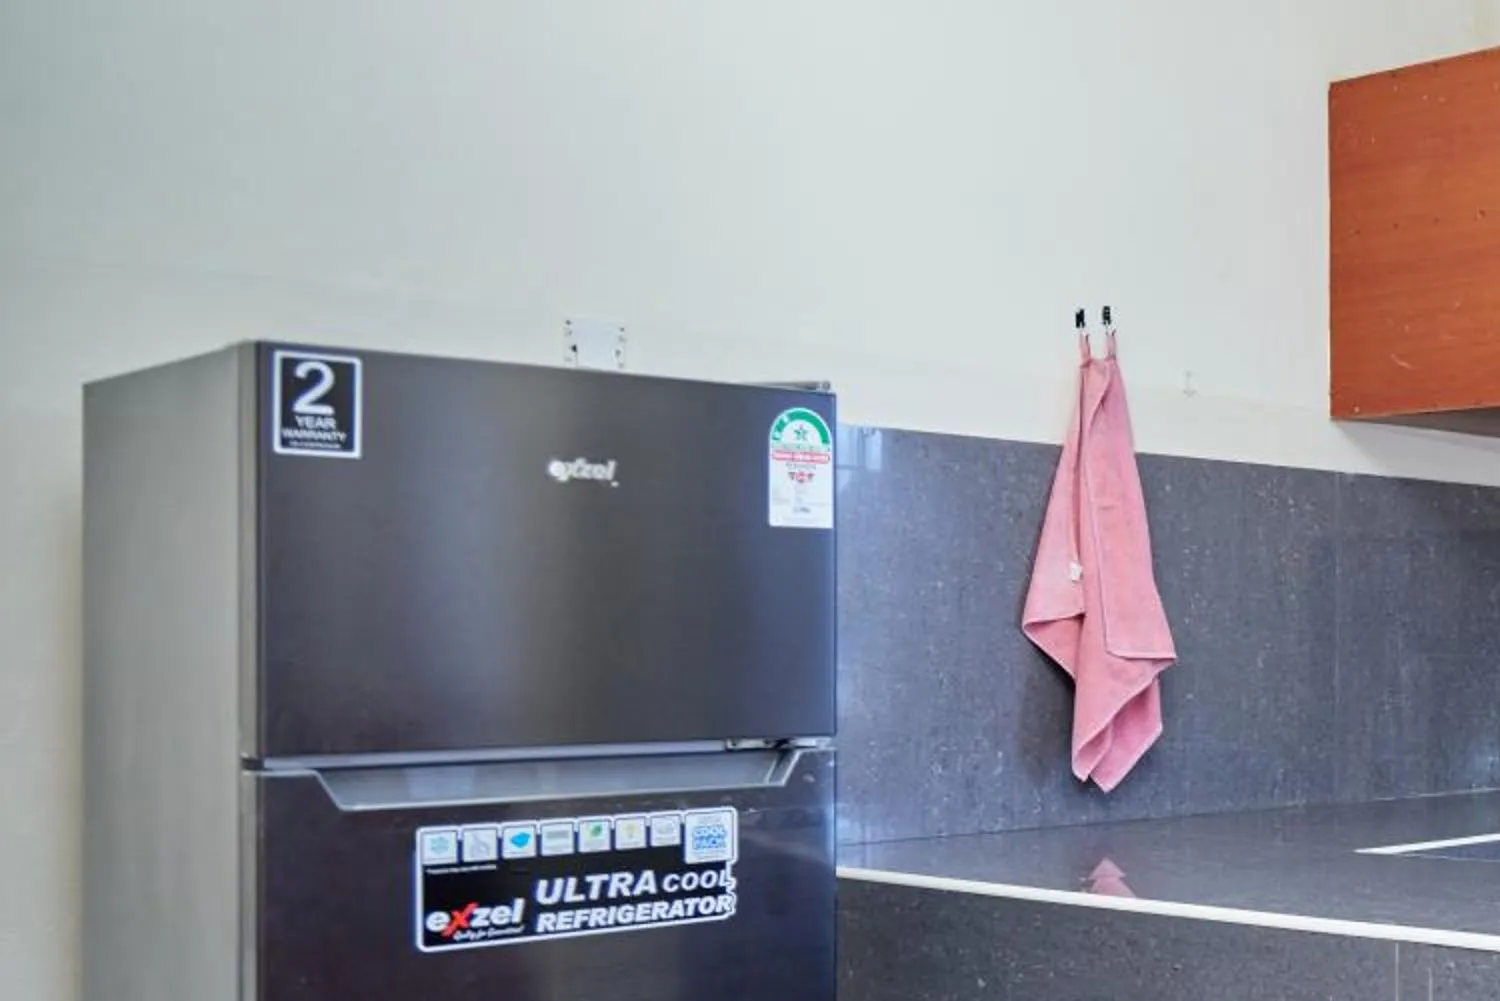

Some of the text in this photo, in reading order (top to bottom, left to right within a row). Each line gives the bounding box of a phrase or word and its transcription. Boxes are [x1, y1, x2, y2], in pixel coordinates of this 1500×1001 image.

[293, 361, 335, 415] 2
[281, 428, 347, 442] WARRANTY
[295, 415, 336, 429] YEAR
[536, 868, 731, 905] ULTRA COOL
[425, 897, 525, 937] exzel
[535, 894, 734, 932] REFRIGERATOR
